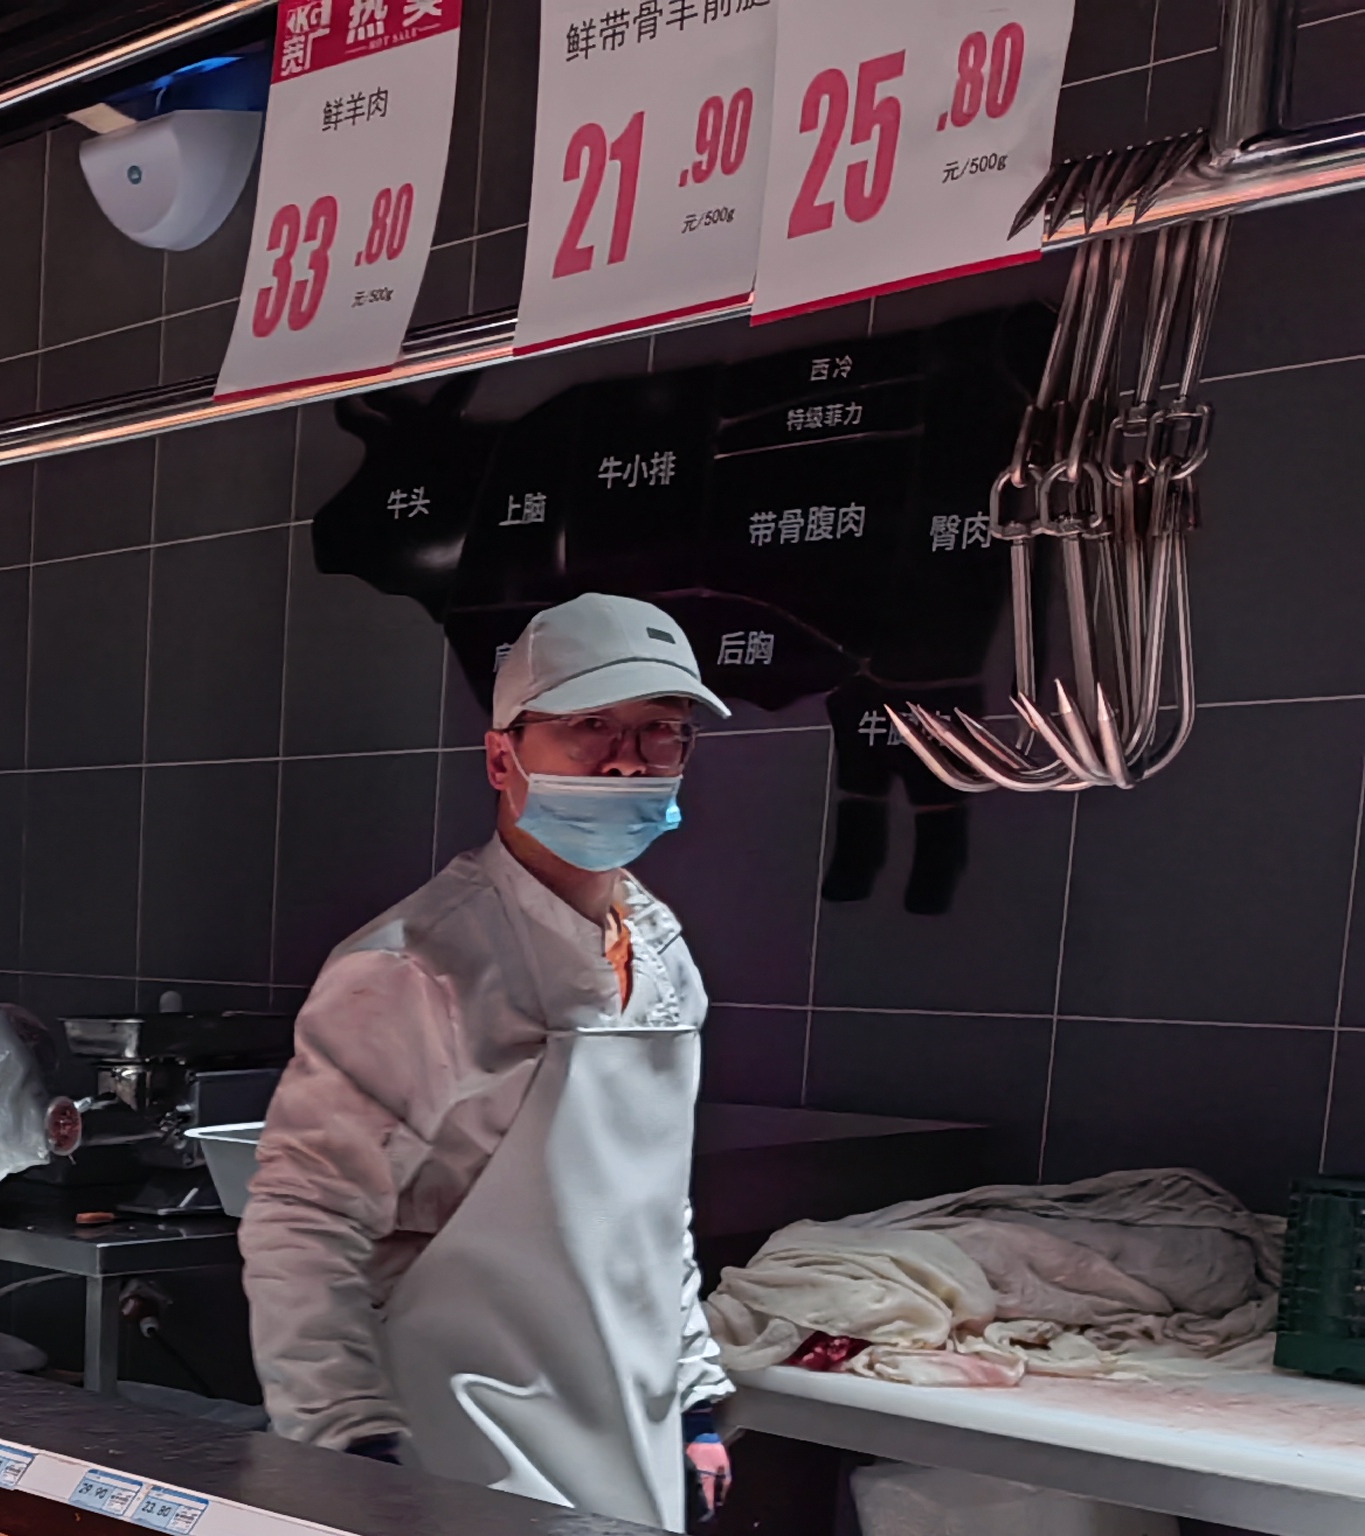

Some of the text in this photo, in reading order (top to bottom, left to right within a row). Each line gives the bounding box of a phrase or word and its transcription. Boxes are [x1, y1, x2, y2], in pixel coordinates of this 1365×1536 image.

[566, 0, 768, 62] 鲜带骨羊前
[322, 86, 389, 131] 鲜羊肉
[786, 49, 906, 239] 25
[942, 152, 1008, 184] 元/500g
[552, 110, 645, 279] 21
[681, 205, 736, 234] 元/500g
[252, 195, 338, 338] 33
[809, 354, 853, 381] 西冷
[786, 401, 863, 431] 特级菲力
[598, 451, 677, 489] 牛小排
[386, 486, 430, 519] 牛头
[498, 491, 547, 527] 上脑
[749, 502, 866, 547] 带骨腹肉
[930, 511, 992, 552] 臀肉
[717, 630, 775, 665] 后胸
